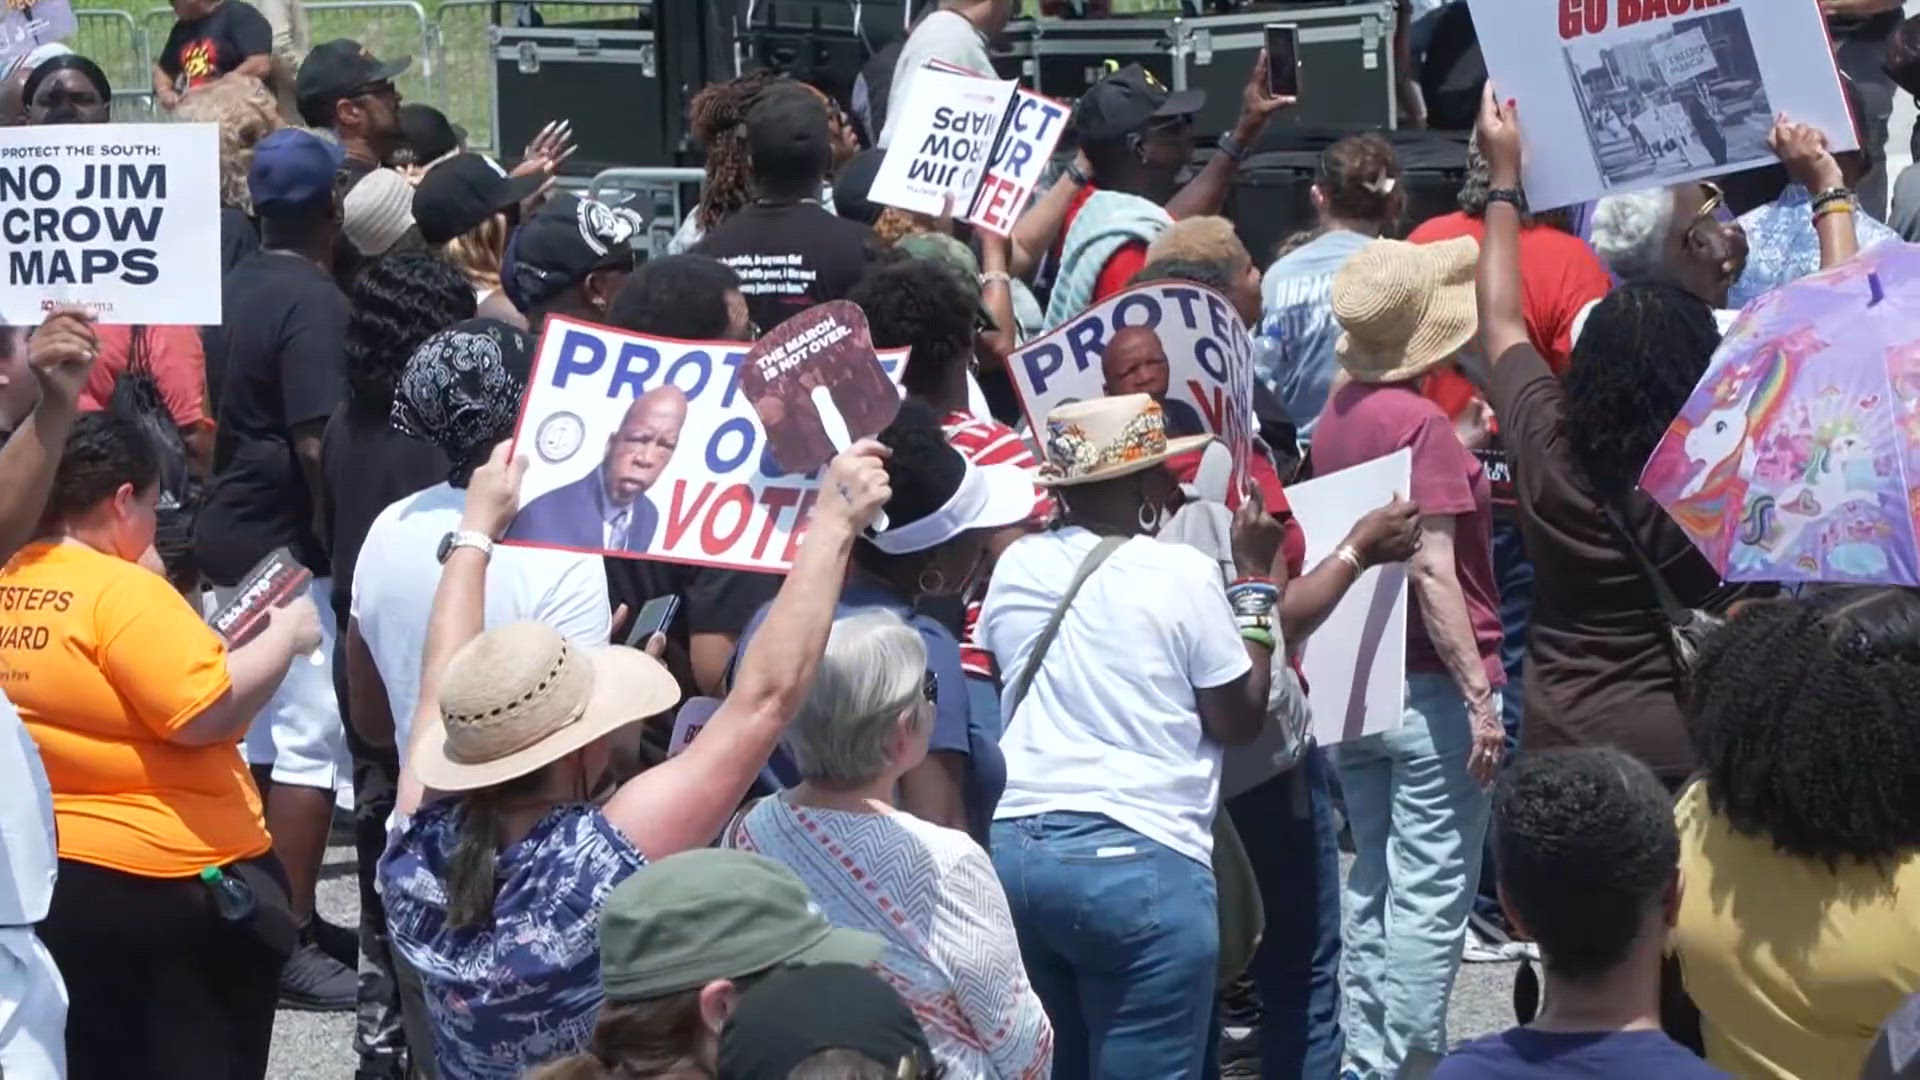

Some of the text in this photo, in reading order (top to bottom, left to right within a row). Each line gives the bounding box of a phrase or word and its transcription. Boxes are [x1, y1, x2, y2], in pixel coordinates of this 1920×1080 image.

[1, 144, 161, 158] PROTECT THE SOUTH:
[0, 164, 167, 201] NO JIM
[907, 158, 960, 187] JIM
[3, 205, 164, 244] CROW
[9, 248, 160, 285] MAPS
[755, 315, 838, 370] THE MARCH
[762, 324, 853, 382] IS NOT OVER.
